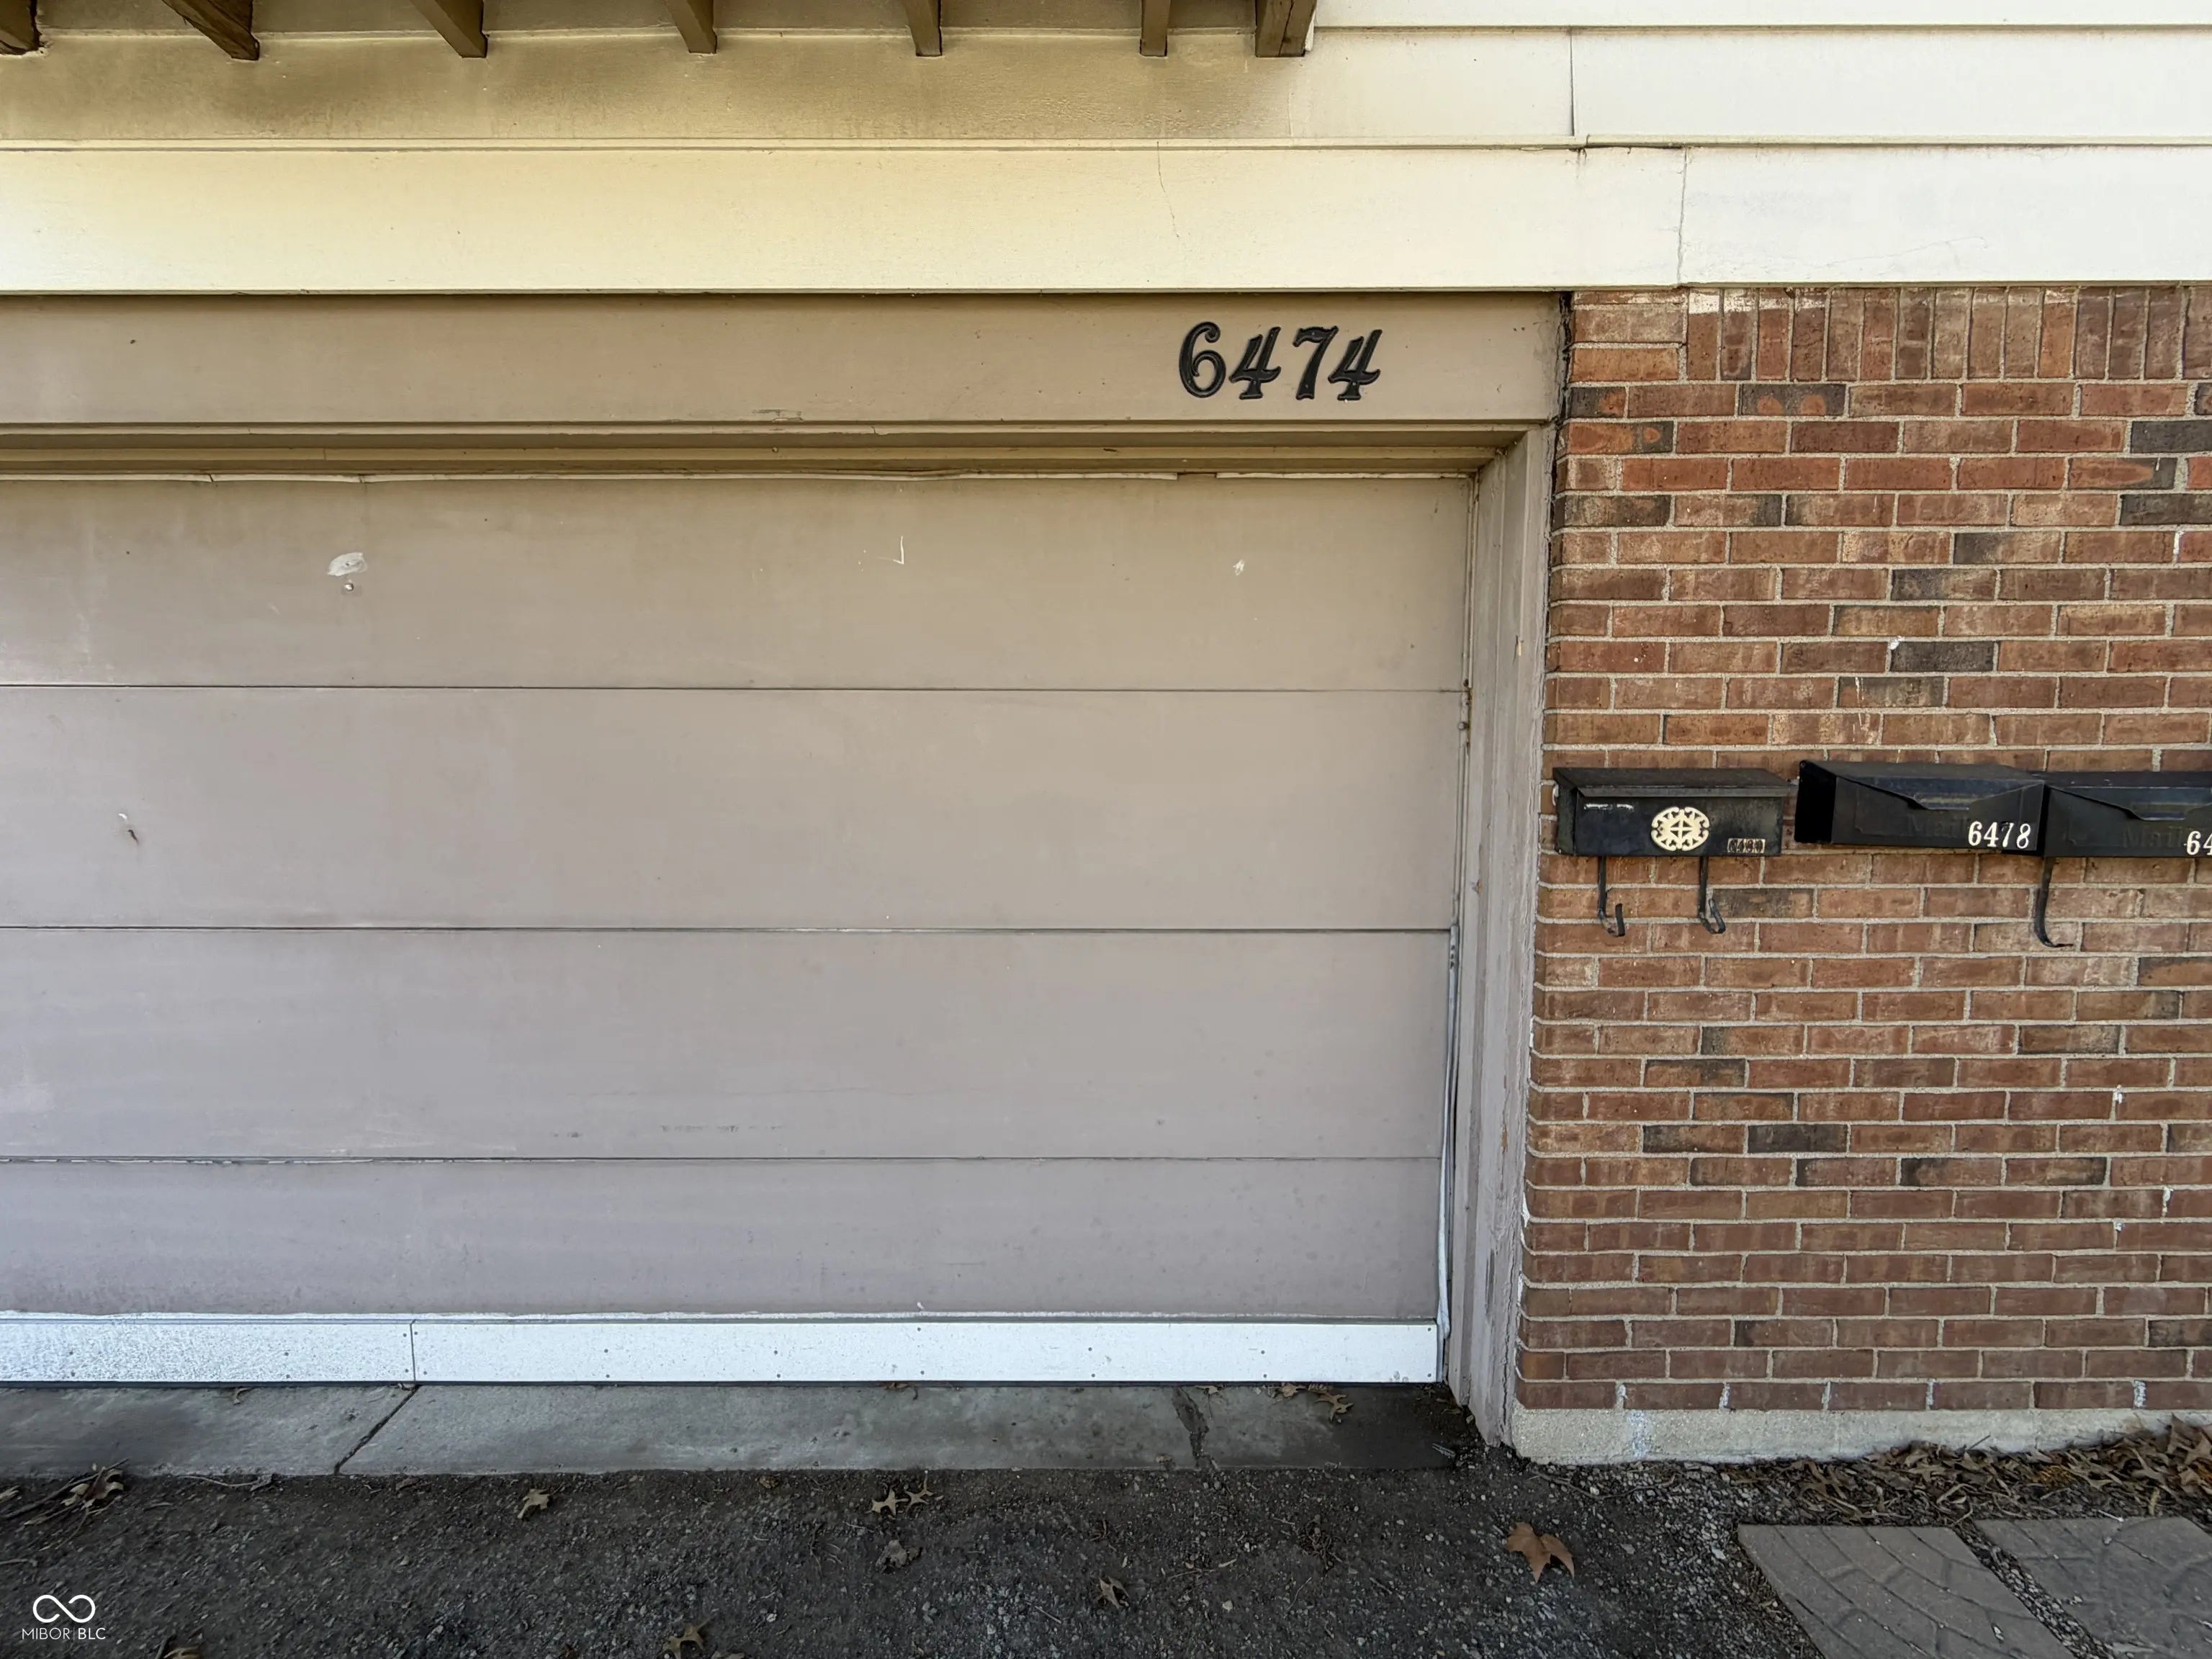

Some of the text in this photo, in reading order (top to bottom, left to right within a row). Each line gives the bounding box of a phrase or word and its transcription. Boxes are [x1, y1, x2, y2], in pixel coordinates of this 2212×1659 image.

[1179, 321, 1382, 400] 6474
[1968, 821, 2031, 849] 6478
[2123, 825, 2183, 848] Mail
